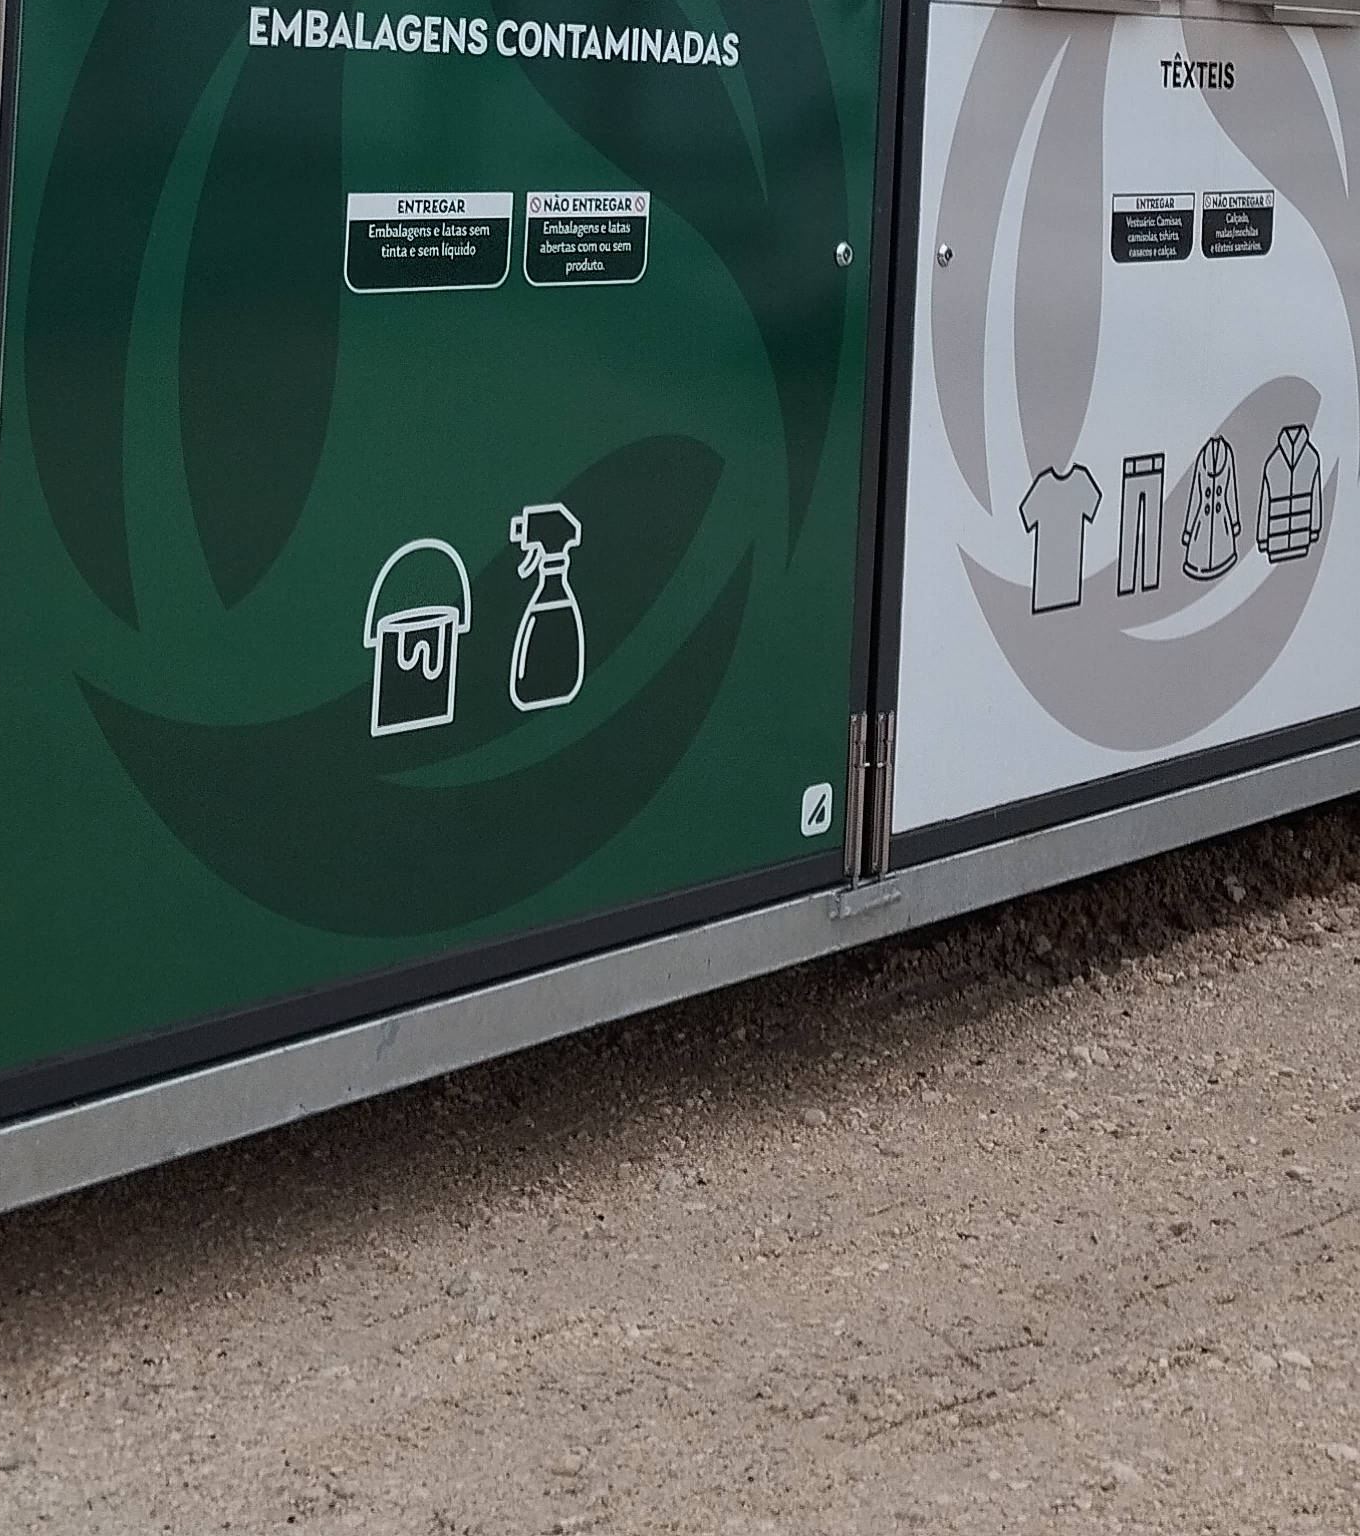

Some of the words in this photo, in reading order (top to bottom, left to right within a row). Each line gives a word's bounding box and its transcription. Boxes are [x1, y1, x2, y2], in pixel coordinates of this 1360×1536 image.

[249, 5, 488, 56] EMBALAGENS
[496, 20, 740, 67] CONTAMINADAS
[1160, 52, 1235, 89] TÊXTEIS
[398, 199, 465, 214] ENTREGAR
[543, 194, 570, 212] NÃO
[572, 198, 632, 212] ENTREGAR
[1136, 198, 1175, 210] ENTREGAR
[369, 223, 432, 242] Embalagens
[433, 227, 440, 237] e
[442, 222, 468, 237] latas
[469, 225, 490, 237] sem
[543, 220, 600, 238] Embalagens
[600, 225, 607, 234] e
[608, 220, 631, 234] latas
[381, 244, 407, 258] tinta
[409, 247, 416, 257] e
[418, 246, 440, 257] sem
[441, 240, 477, 260] líquido
[539, 240, 577, 253] abertas
[577, 242, 598, 252] com
[599, 242, 611, 252] ou
[612, 242, 632, 252] sem
